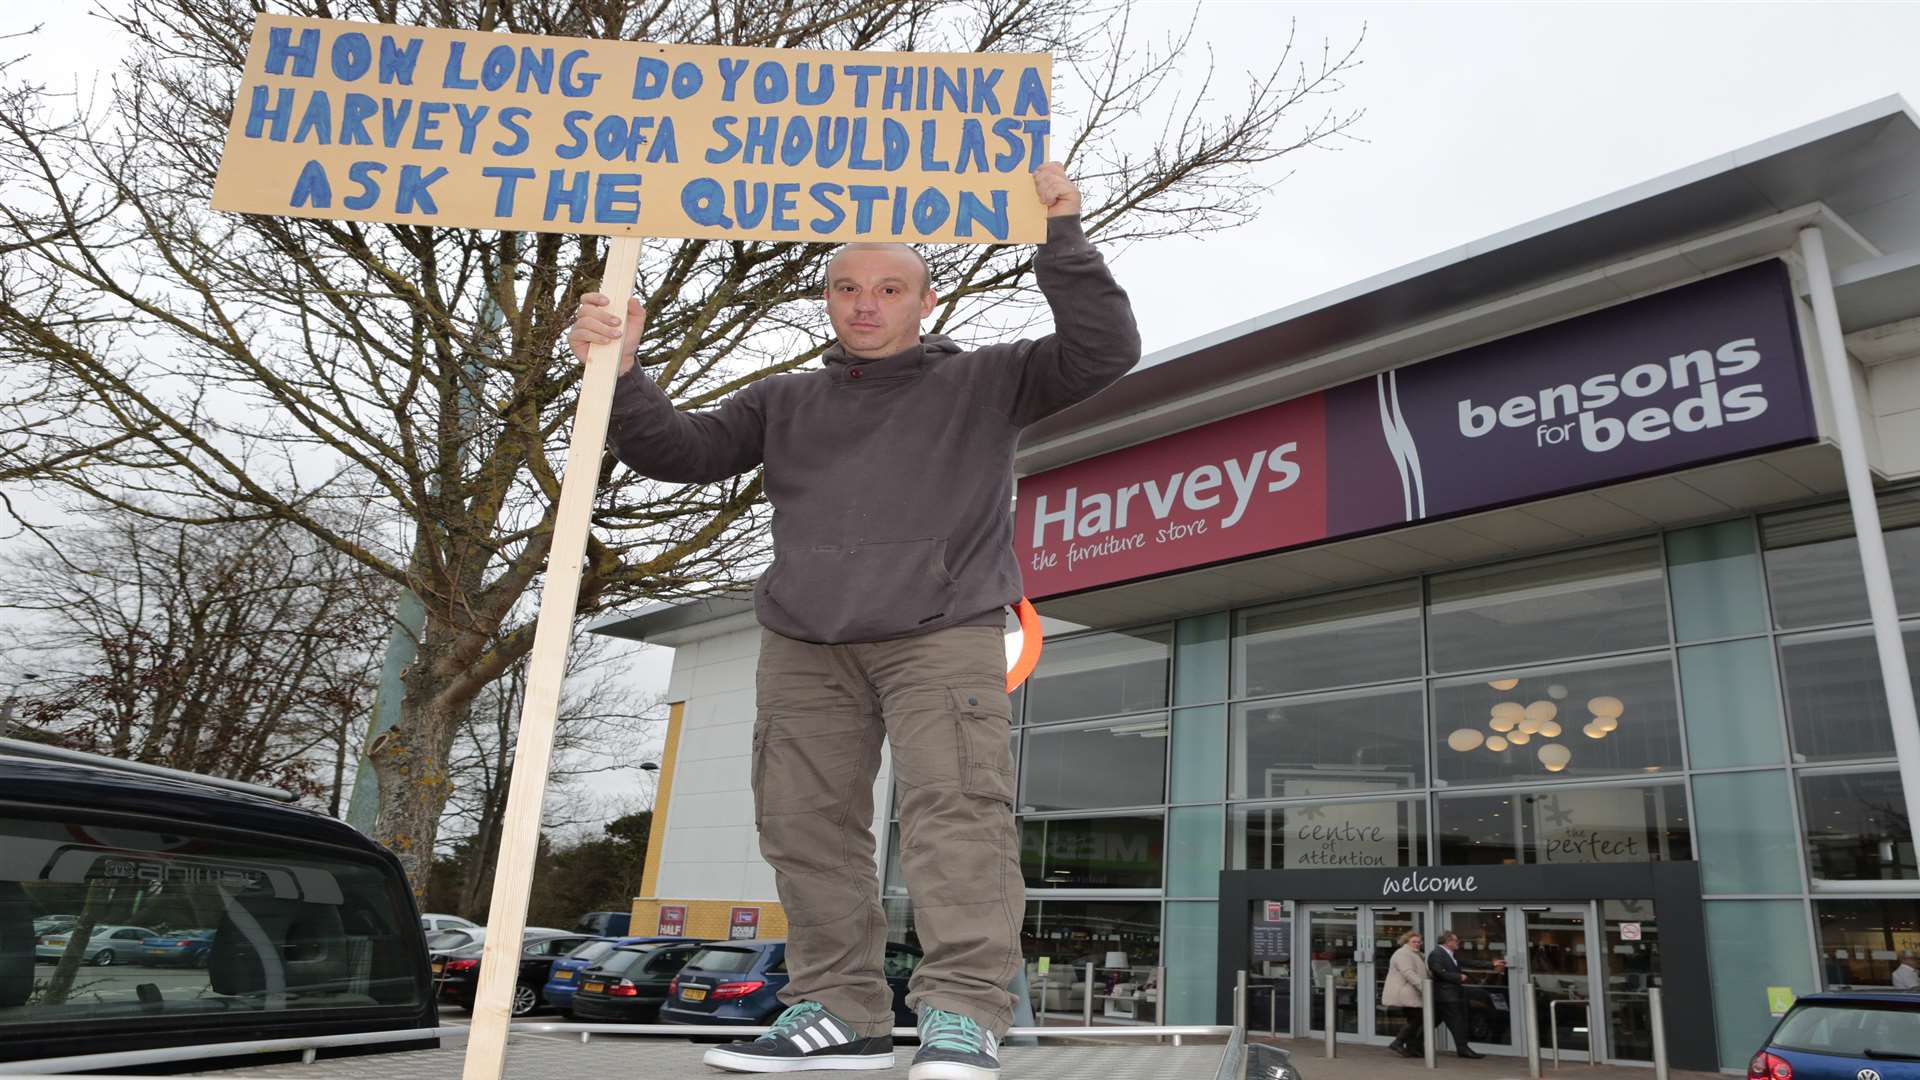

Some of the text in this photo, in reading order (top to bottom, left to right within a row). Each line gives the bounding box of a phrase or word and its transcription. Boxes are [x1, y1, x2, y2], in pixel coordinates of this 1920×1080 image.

[265, 27, 1050, 116] HOW LONG DO YOU THINK A
[245, 85, 1050, 174] HARVEYS SOFA SHOULD LAST
[289, 159, 1009, 240] ASK THE QUESTION
[1458, 338, 1761, 438] bensons
[1536, 381, 1768, 452] for beds
[1032, 441, 1300, 548] Harveys
[1031, 518, 1208, 571] the furniture store
[1297, 820, 1385, 842] centre
[1321, 839, 1337, 852] of
[1545, 831, 1640, 862] perfect
[1296, 850, 1387, 866] attention
[1383, 871, 1478, 895] welcome
[658, 923, 681, 936] HALF
